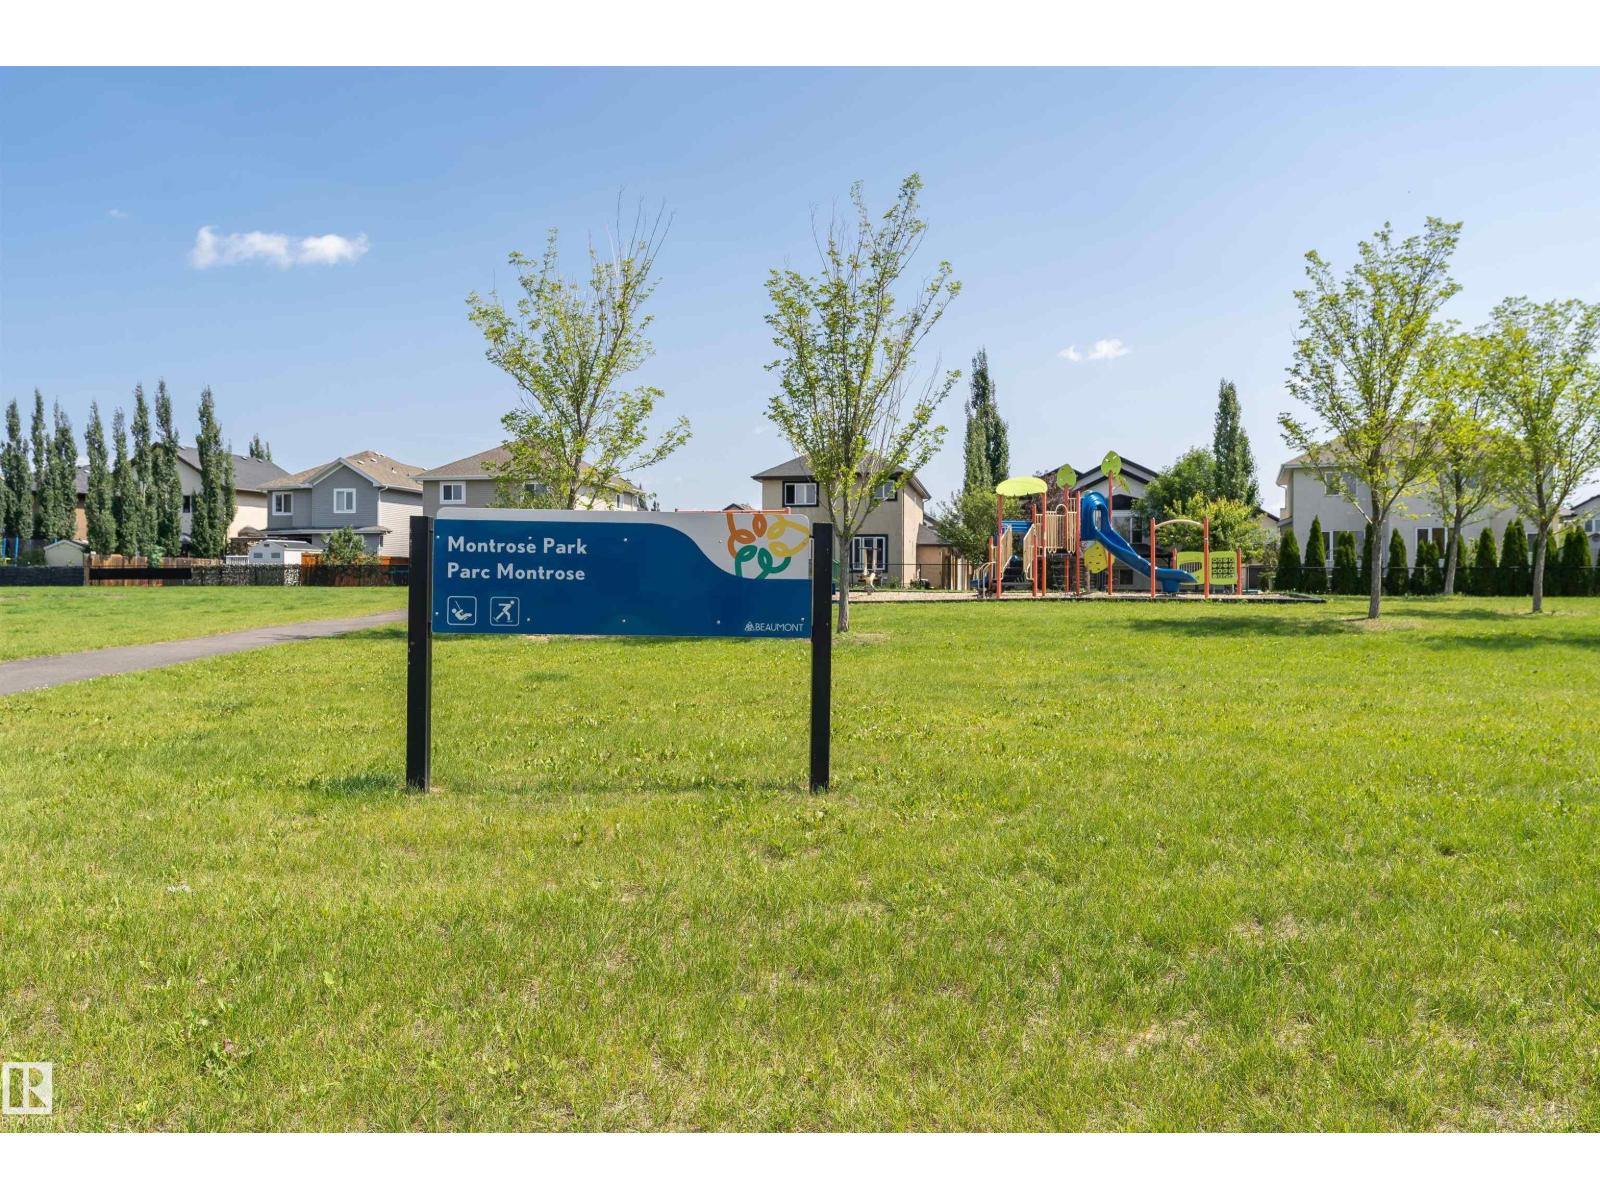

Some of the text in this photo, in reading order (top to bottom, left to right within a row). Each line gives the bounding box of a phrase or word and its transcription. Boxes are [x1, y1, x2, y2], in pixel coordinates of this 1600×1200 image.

[447, 535, 587, 555] Montrose Park
[447, 562, 585, 581] Parc Montrose
[755, 622, 804, 632] BEAUMONT
